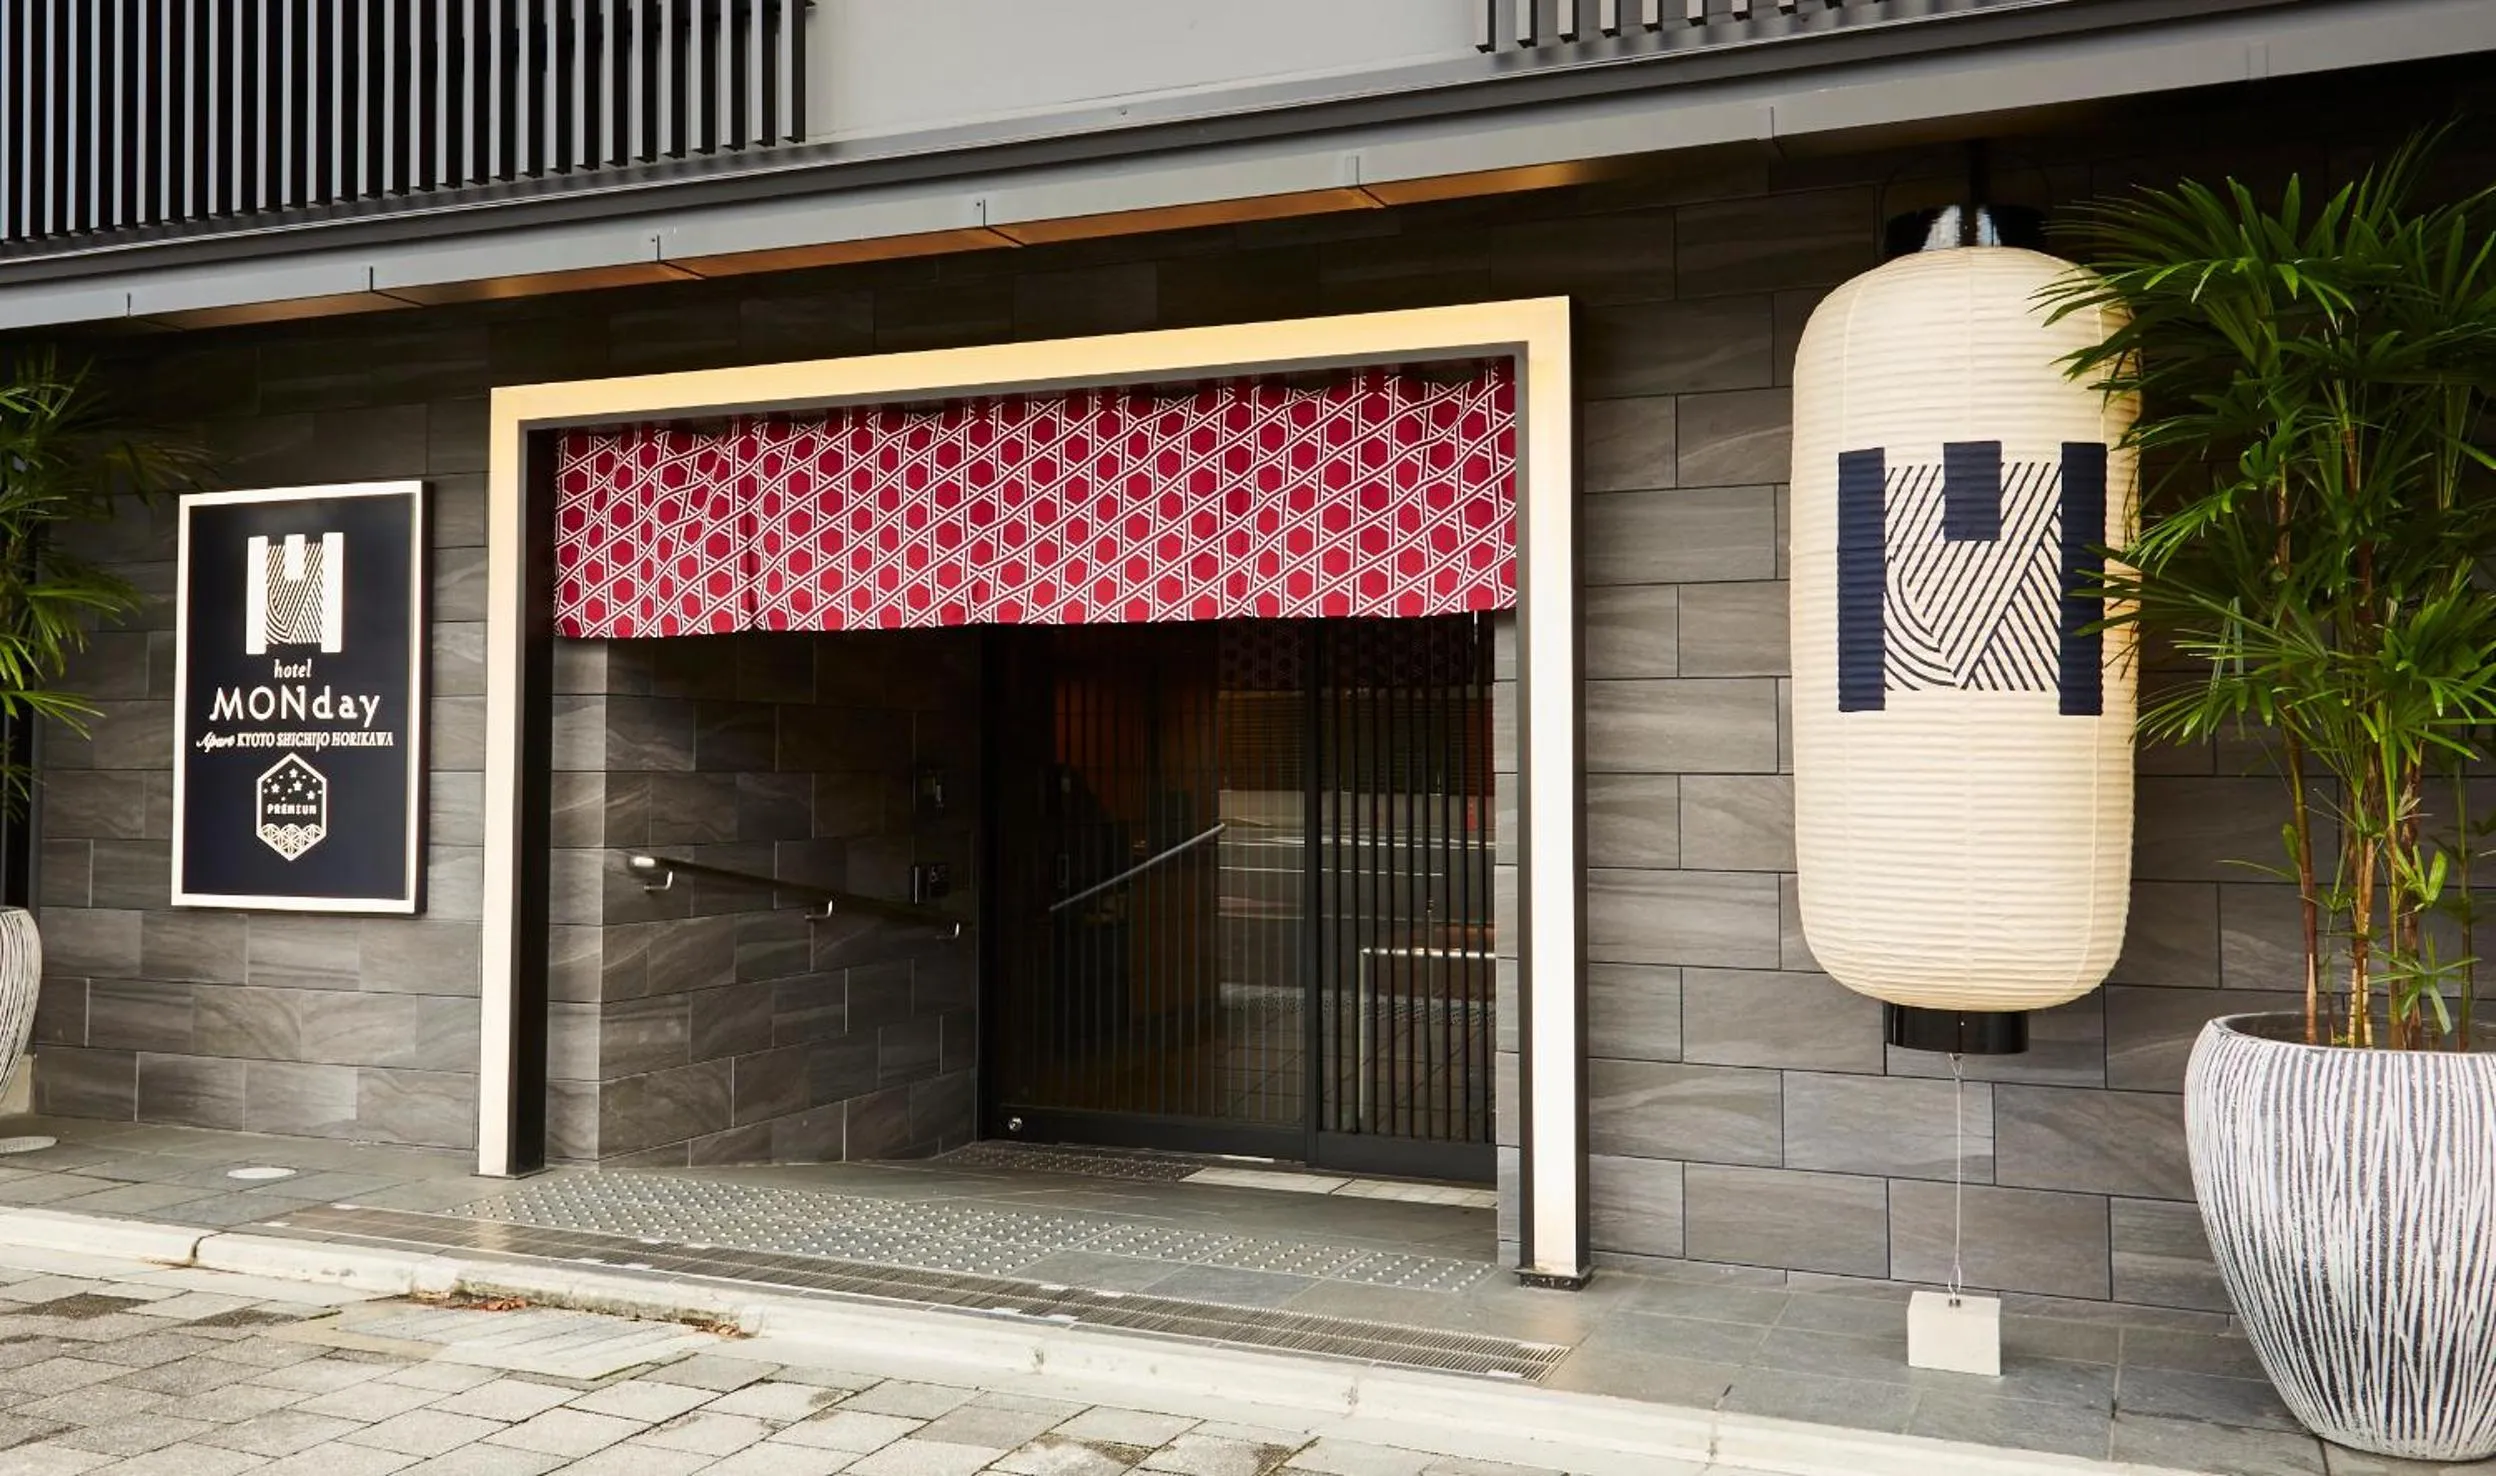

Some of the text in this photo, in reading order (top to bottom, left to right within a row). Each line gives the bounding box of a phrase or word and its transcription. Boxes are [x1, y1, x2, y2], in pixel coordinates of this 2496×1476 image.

[274, 658, 313, 679] hotel
[209, 684, 381, 728] MONday
[236, 732, 276, 748] KYOTO
[275, 731, 331, 752] SHICHIJO
[330, 731, 394, 747] HORIKAWA
[267, 803, 317, 815] PREMIUM
